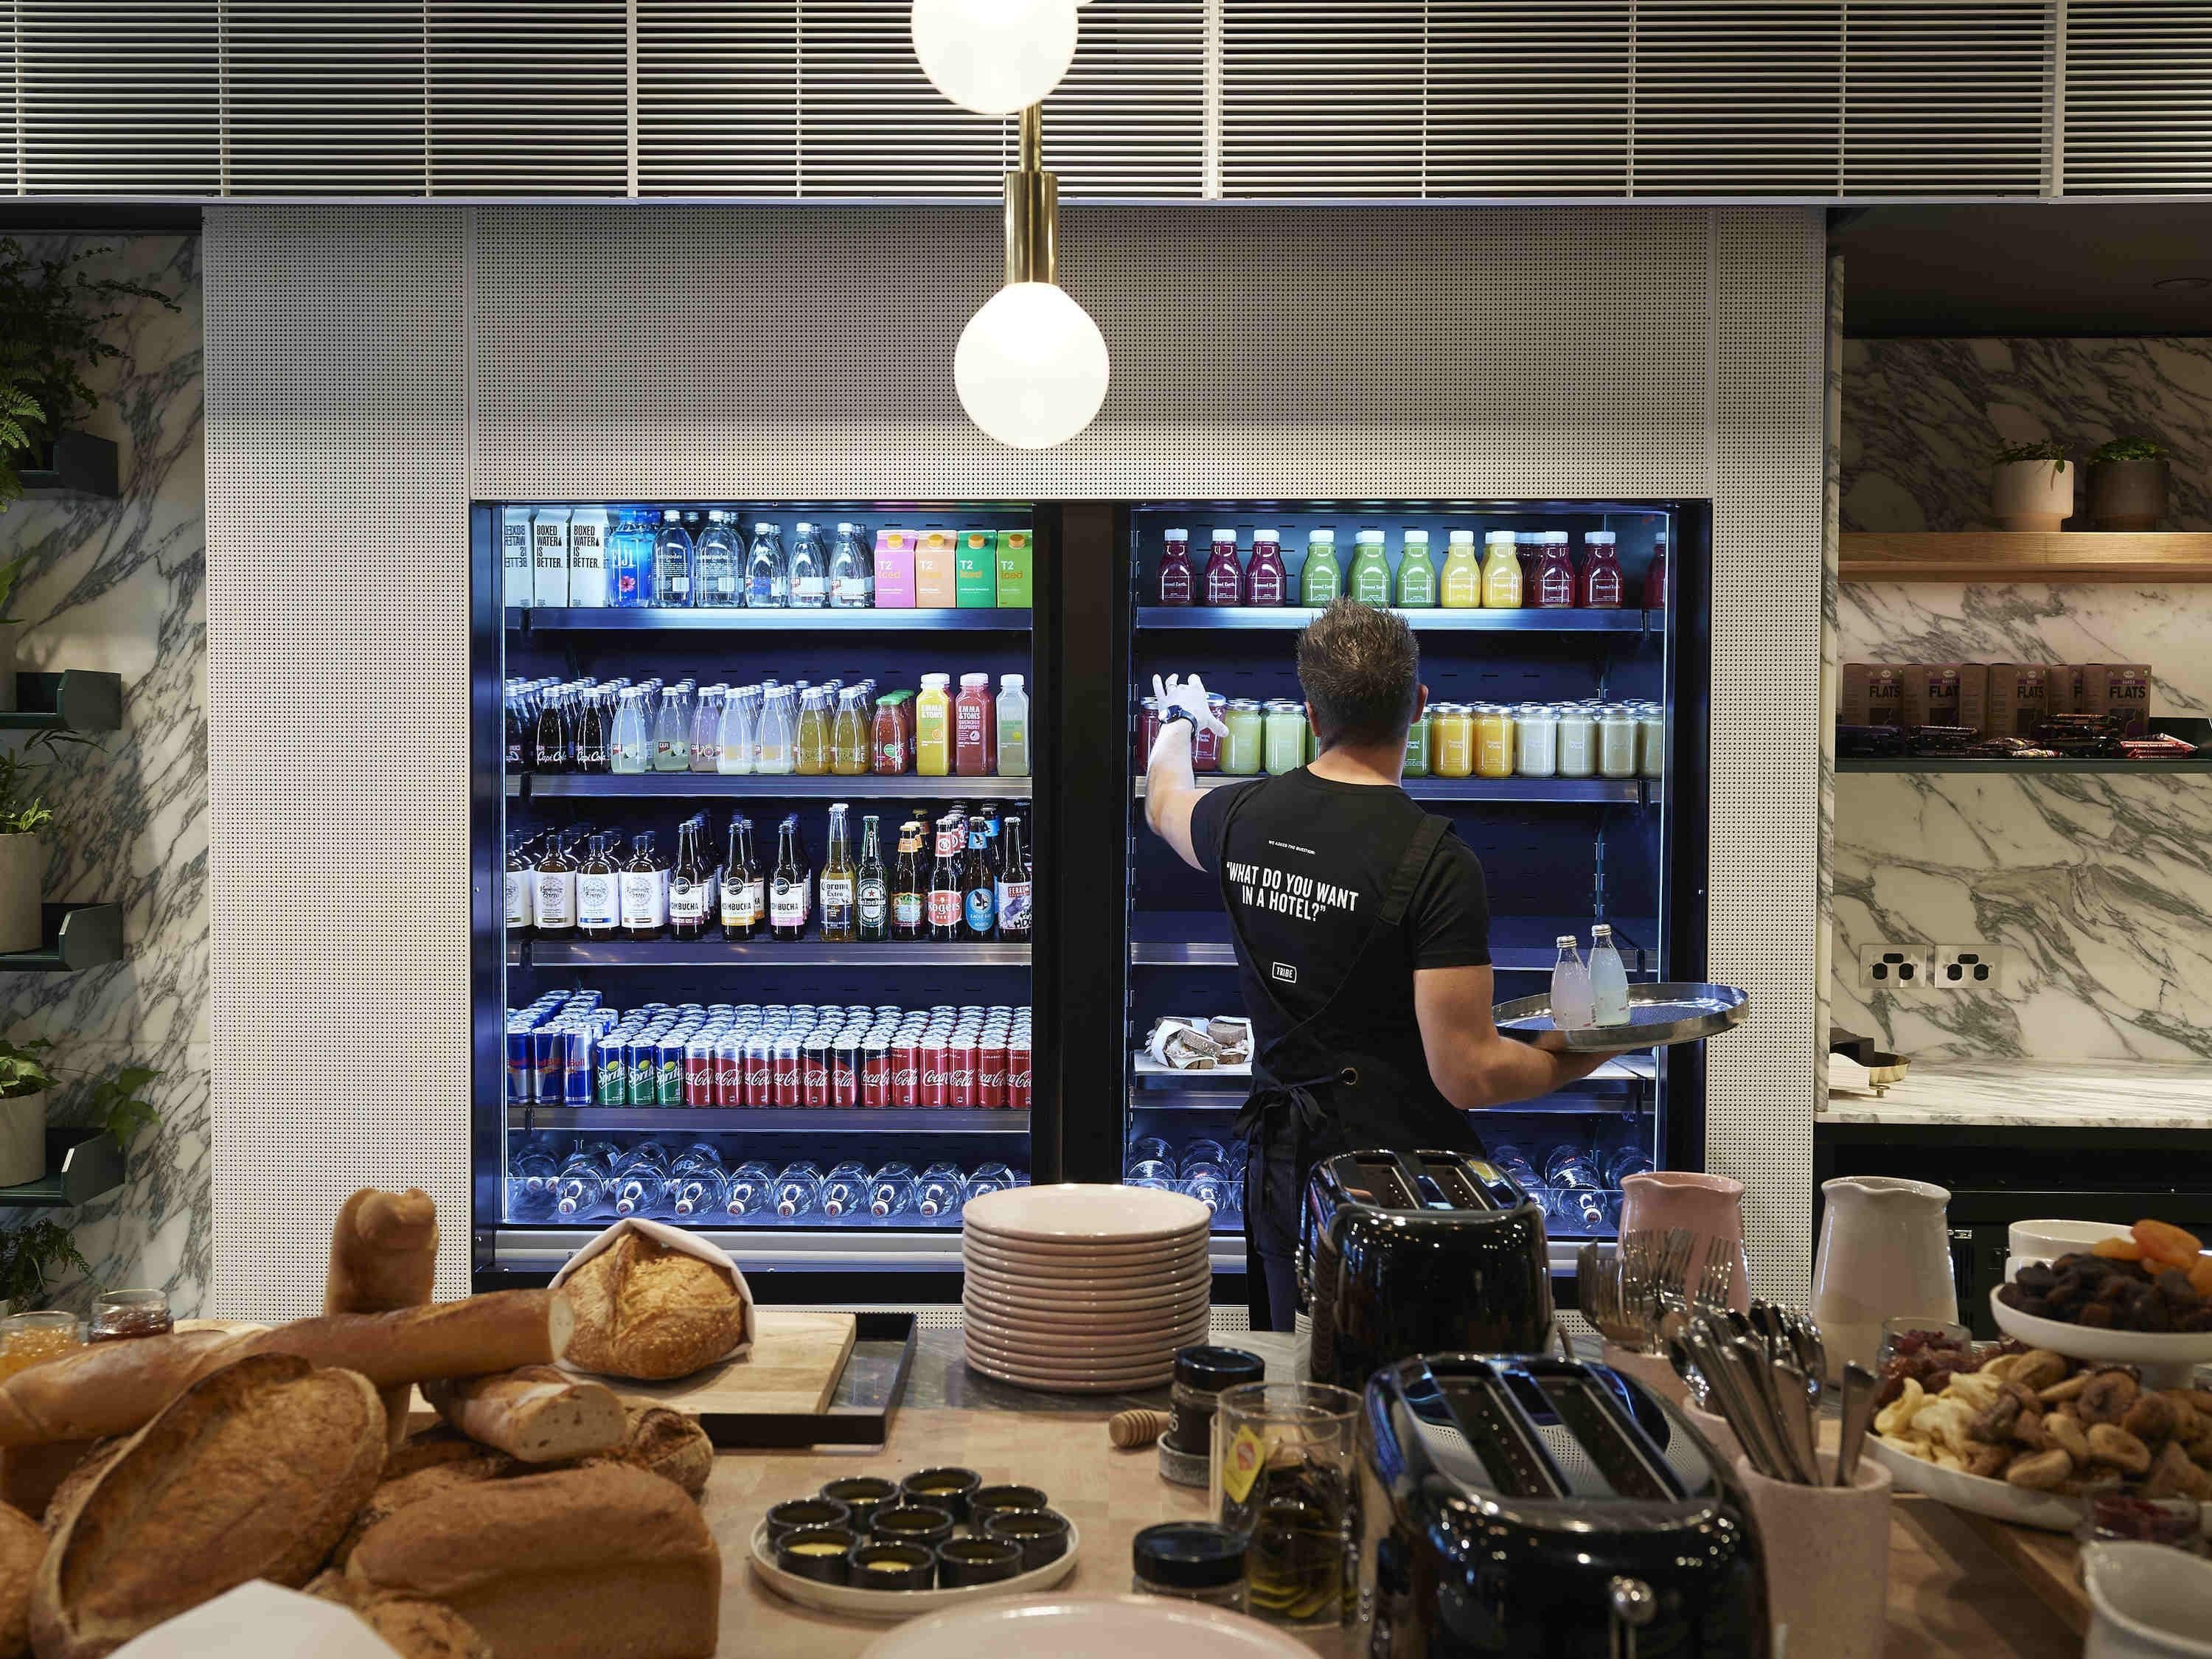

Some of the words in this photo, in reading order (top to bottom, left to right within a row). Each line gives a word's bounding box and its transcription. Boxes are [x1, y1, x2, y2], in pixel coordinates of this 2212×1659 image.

[537, 525, 557, 535] BOXED
[574, 525, 595, 535] BOXED
[537, 536, 558, 546] WATER
[574, 536, 596, 546] WATER
[537, 547, 543, 557] IS
[574, 547, 580, 557] IS
[537, 557, 563, 568] BETTER.
[573, 557, 600, 568] BETTER.
[878, 560, 891, 570] T2
[919, 560, 933, 570] T2
[959, 560, 973, 570] T2
[1001, 561, 1014, 570] T2
[1868, 685, 1900, 698] FLATS
[2017, 686, 2045, 699] FLATS
[2110, 685, 2146, 699] FLATS
[1262, 868, 1281, 890] DO
[1286, 873, 1313, 898] YOU
[1317, 882, 1359, 911] WANT
[1242, 885, 1253, 905] IN
[1256, 888, 1265, 908] A
[1276, 967, 1293, 978] TRIBE
